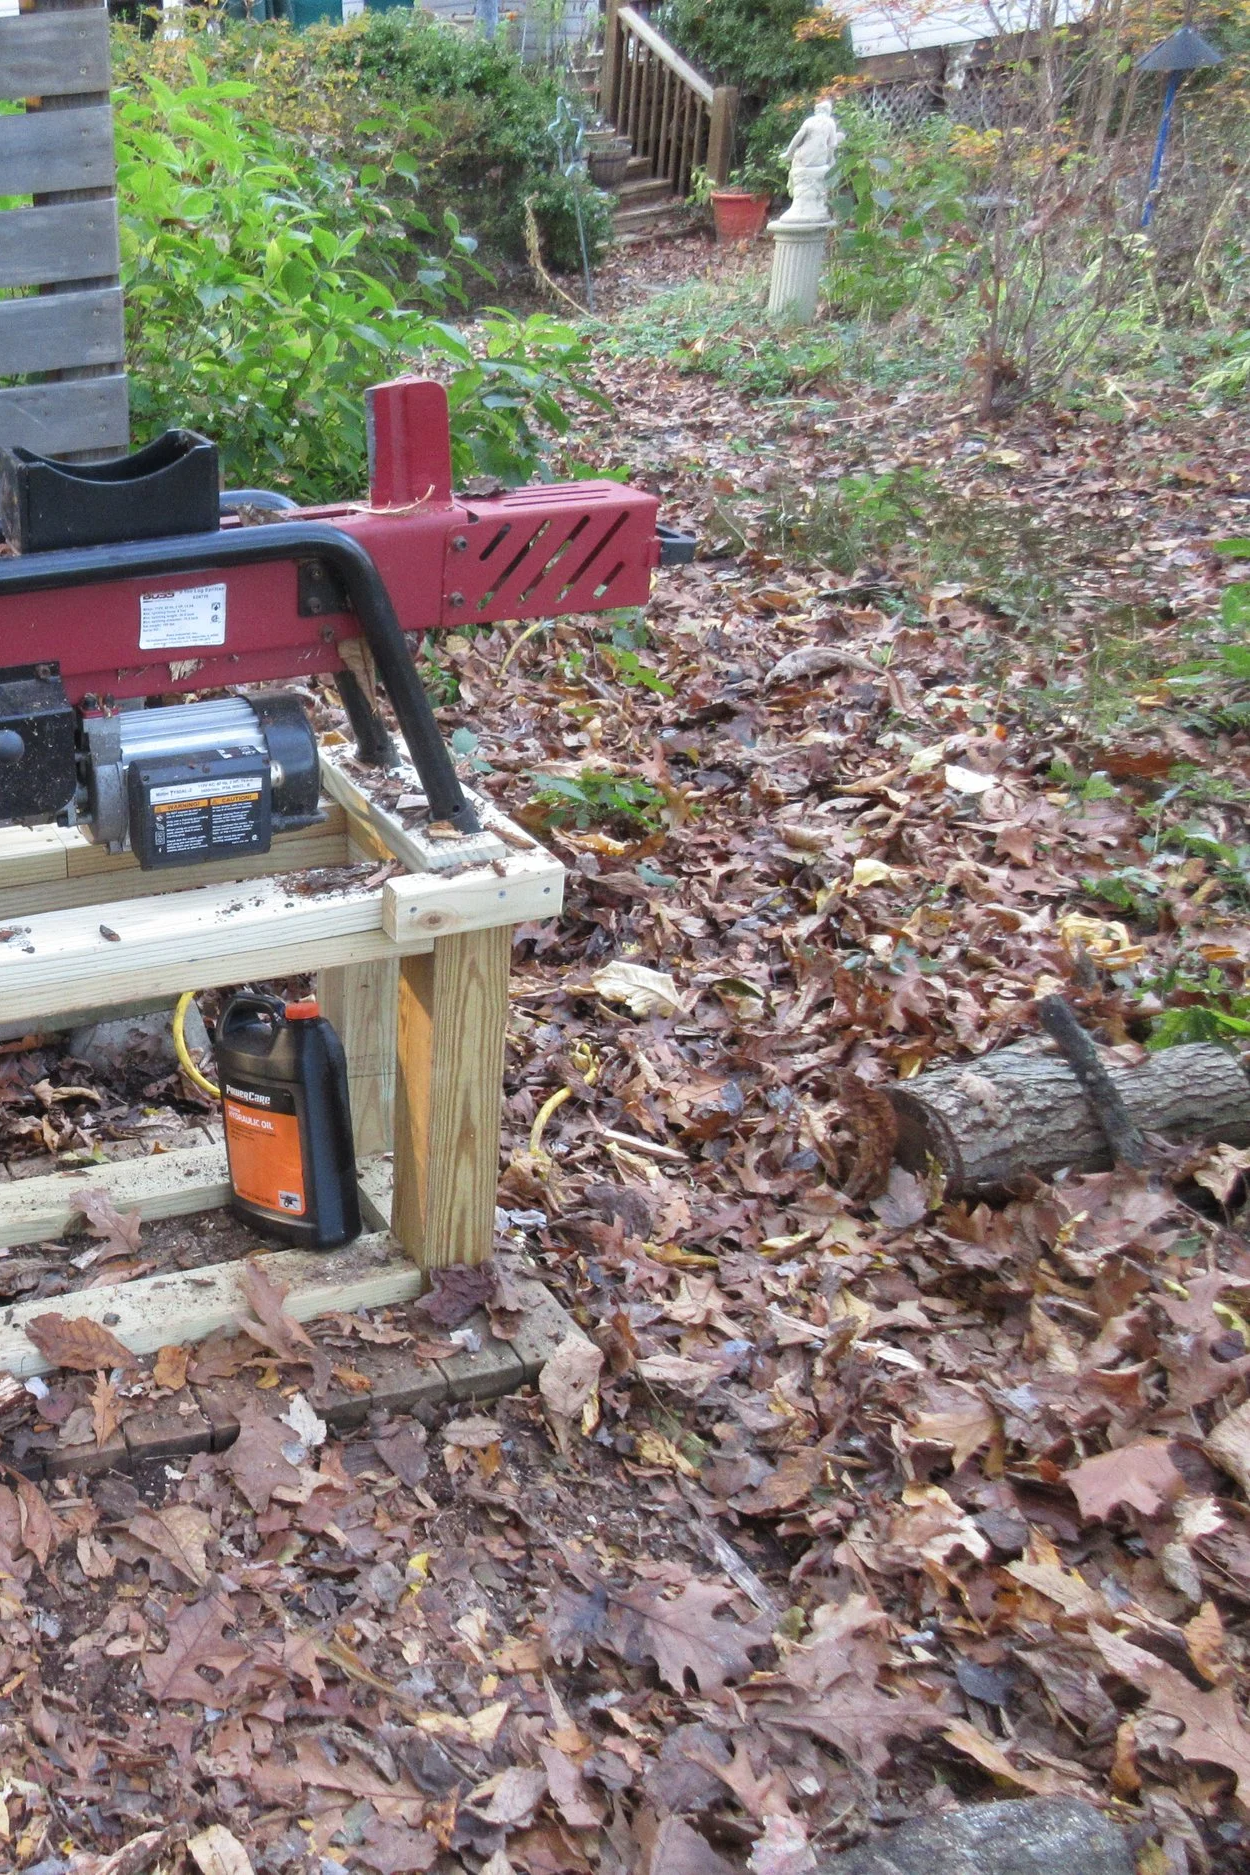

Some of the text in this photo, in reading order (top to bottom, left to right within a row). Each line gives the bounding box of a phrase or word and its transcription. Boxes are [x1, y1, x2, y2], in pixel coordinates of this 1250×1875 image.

[221, 795, 252, 803] CAUTION!
[167, 801, 200, 810] WARNING!
[261, 1120, 274, 1130] OIL
